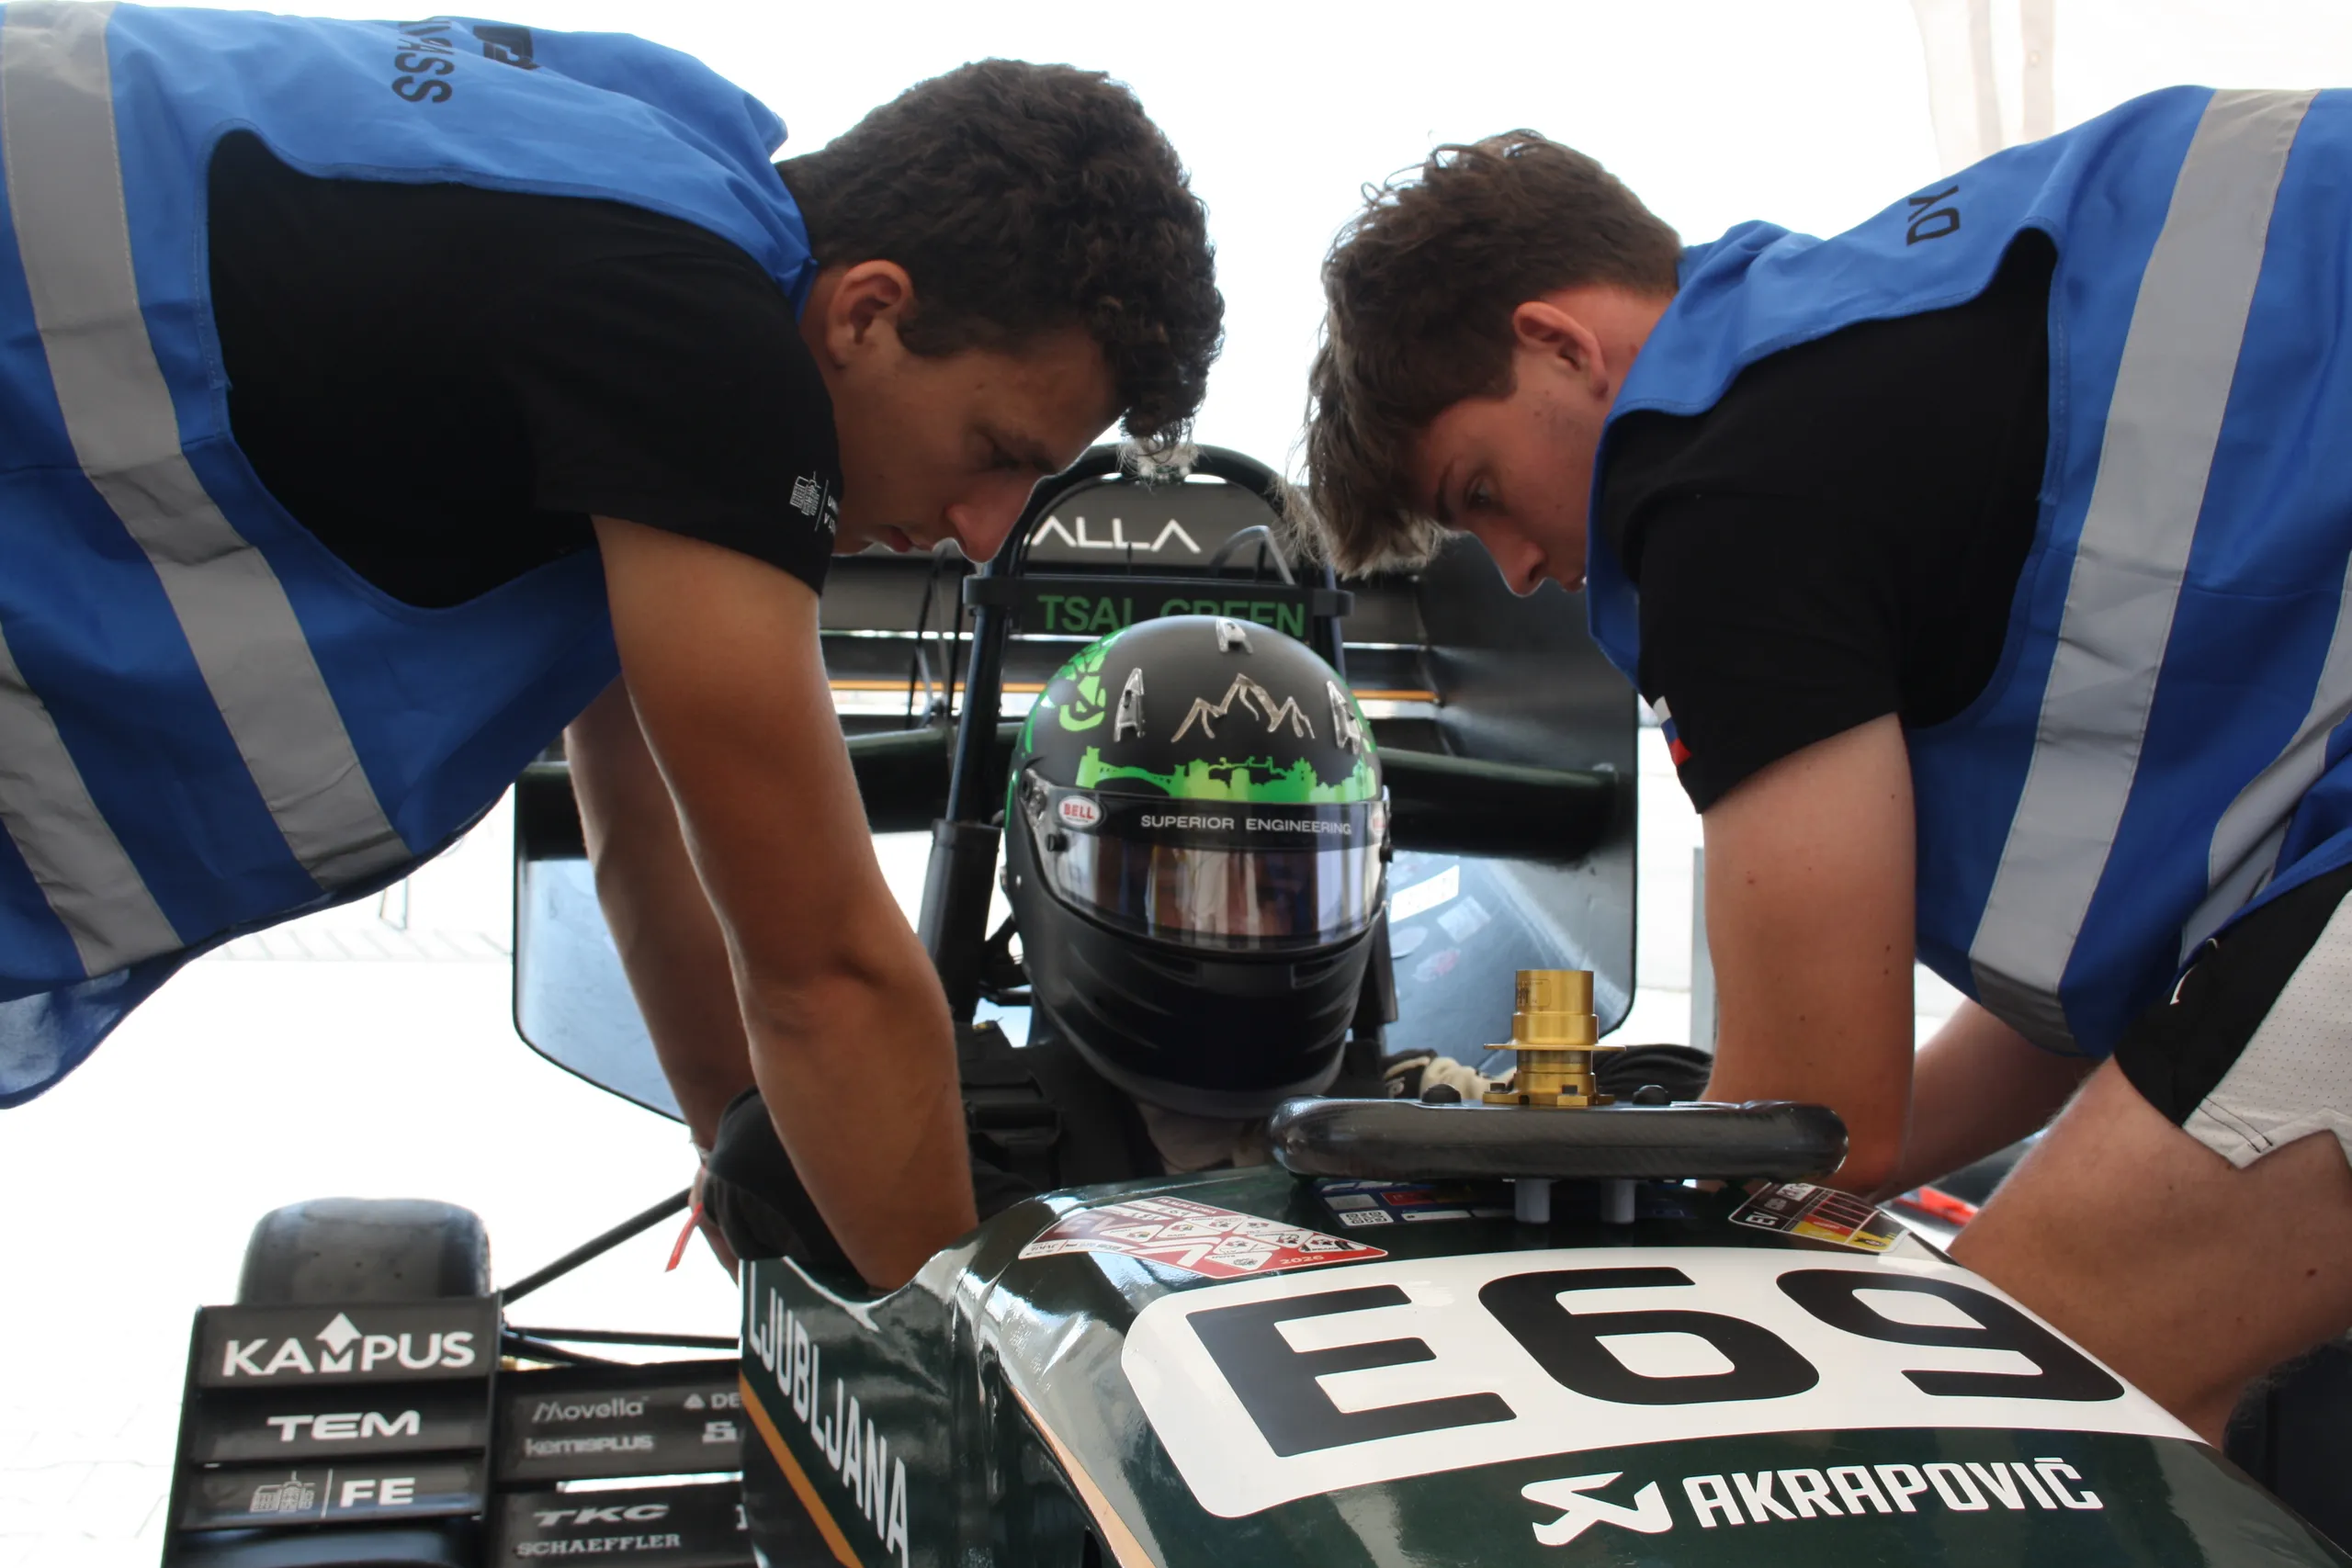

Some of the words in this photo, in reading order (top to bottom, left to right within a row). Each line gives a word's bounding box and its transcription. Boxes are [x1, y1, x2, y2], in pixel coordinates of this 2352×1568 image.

[1023, 515, 1202, 553] ALLA
[1063, 803, 1095, 820] BELL
[1140, 815, 1235, 829] SUPERIOR
[1245, 818, 1352, 835] ENGINEERING
[221, 1313, 476, 1376] KAMPUS
[1185, 1267, 2125, 1458] E69
[267, 1410, 421, 1442] TEM
[749, 1260, 910, 1568] LJUBLJANA
[338, 1476, 416, 1508] FE
[532, 1503, 671, 1528] TKC
[516, 1532, 682, 1556] SCHAEFFLER
